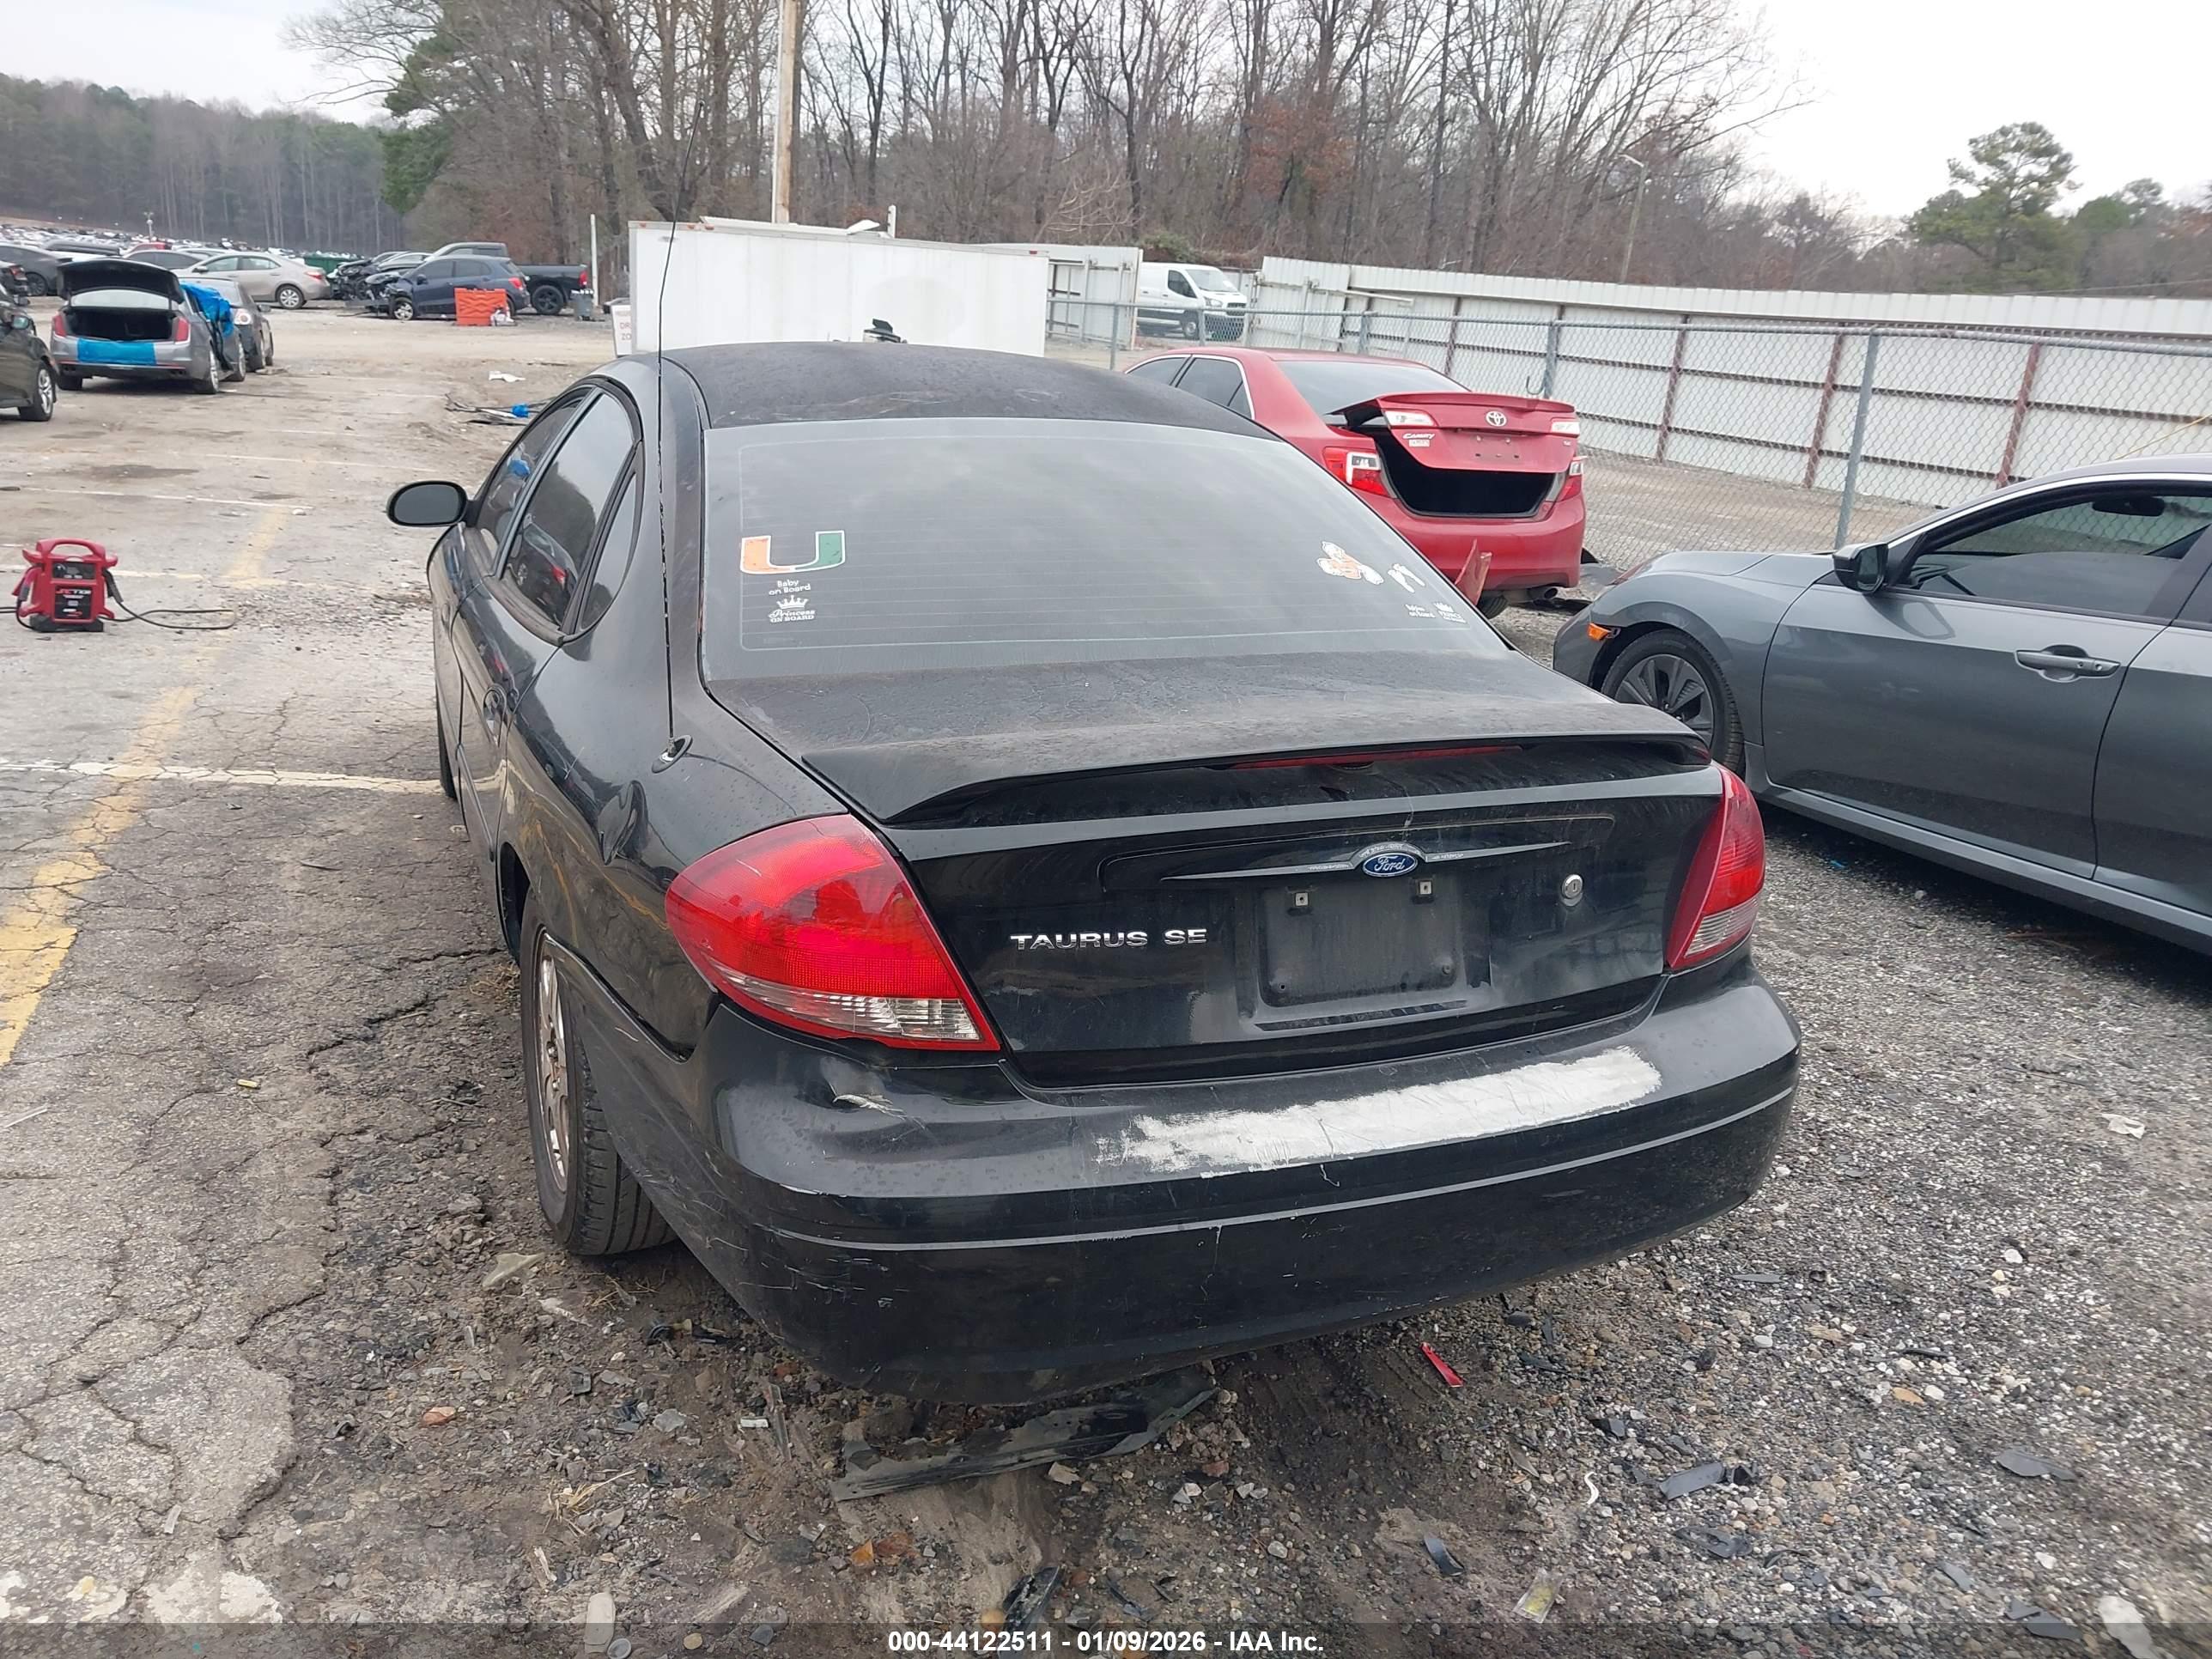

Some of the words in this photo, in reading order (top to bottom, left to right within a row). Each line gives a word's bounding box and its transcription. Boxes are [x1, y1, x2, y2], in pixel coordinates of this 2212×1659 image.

[739, 530, 846, 574] U
[776, 579, 799, 588] Baby
[782, 583, 811, 593] Board
[1374, 855, 1407, 872] Ford
[1010, 931, 1148, 951] TAURUS
[1164, 928, 1207, 945] SE
